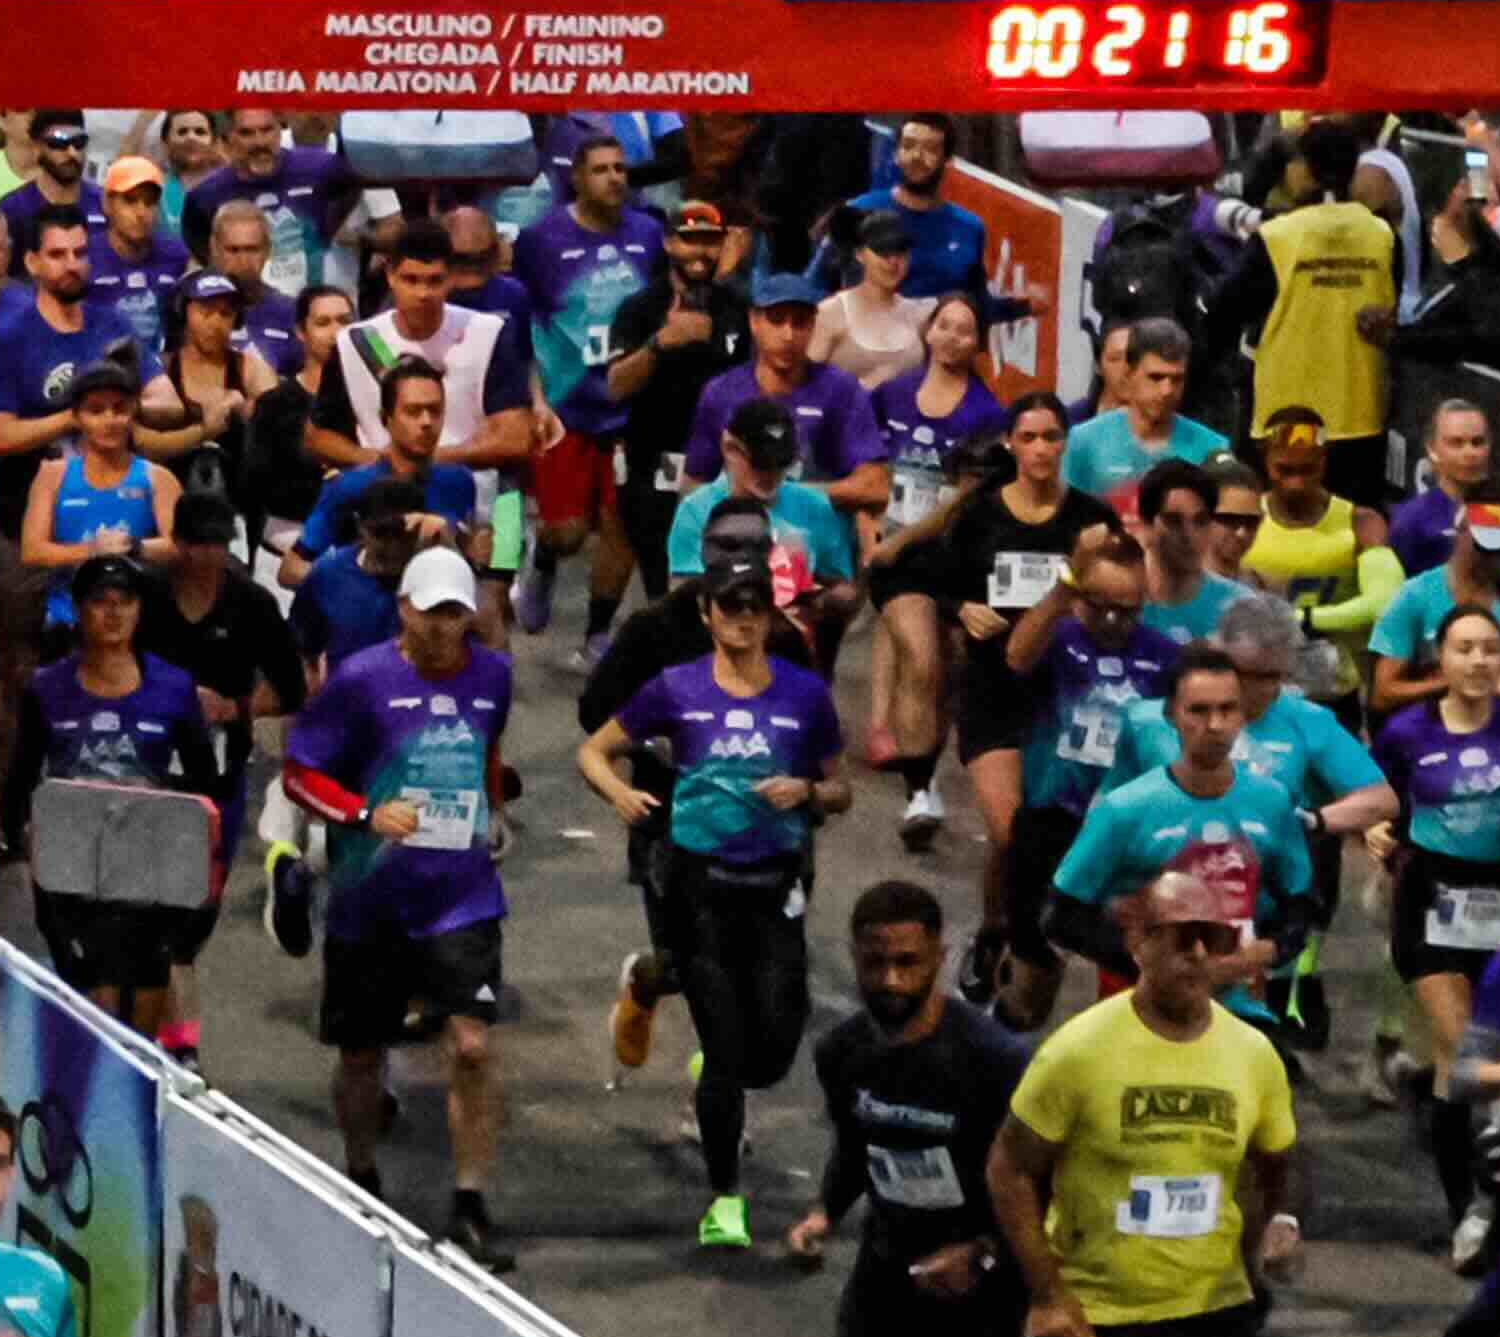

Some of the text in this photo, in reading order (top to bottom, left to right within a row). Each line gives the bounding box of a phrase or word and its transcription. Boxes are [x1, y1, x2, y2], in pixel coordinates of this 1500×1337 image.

[324, 14, 492, 38] MASCULINO
[523, 14, 665, 39] FEMININO
[365, 42, 499, 67] CHEGADA
[533, 43, 623, 66] FINISH
[237, 70, 307, 95] MEIA
[313, 70, 476, 95] MARATONA
[510, 71, 577, 95] HALF
[585, 71, 749, 95] MARATHON
